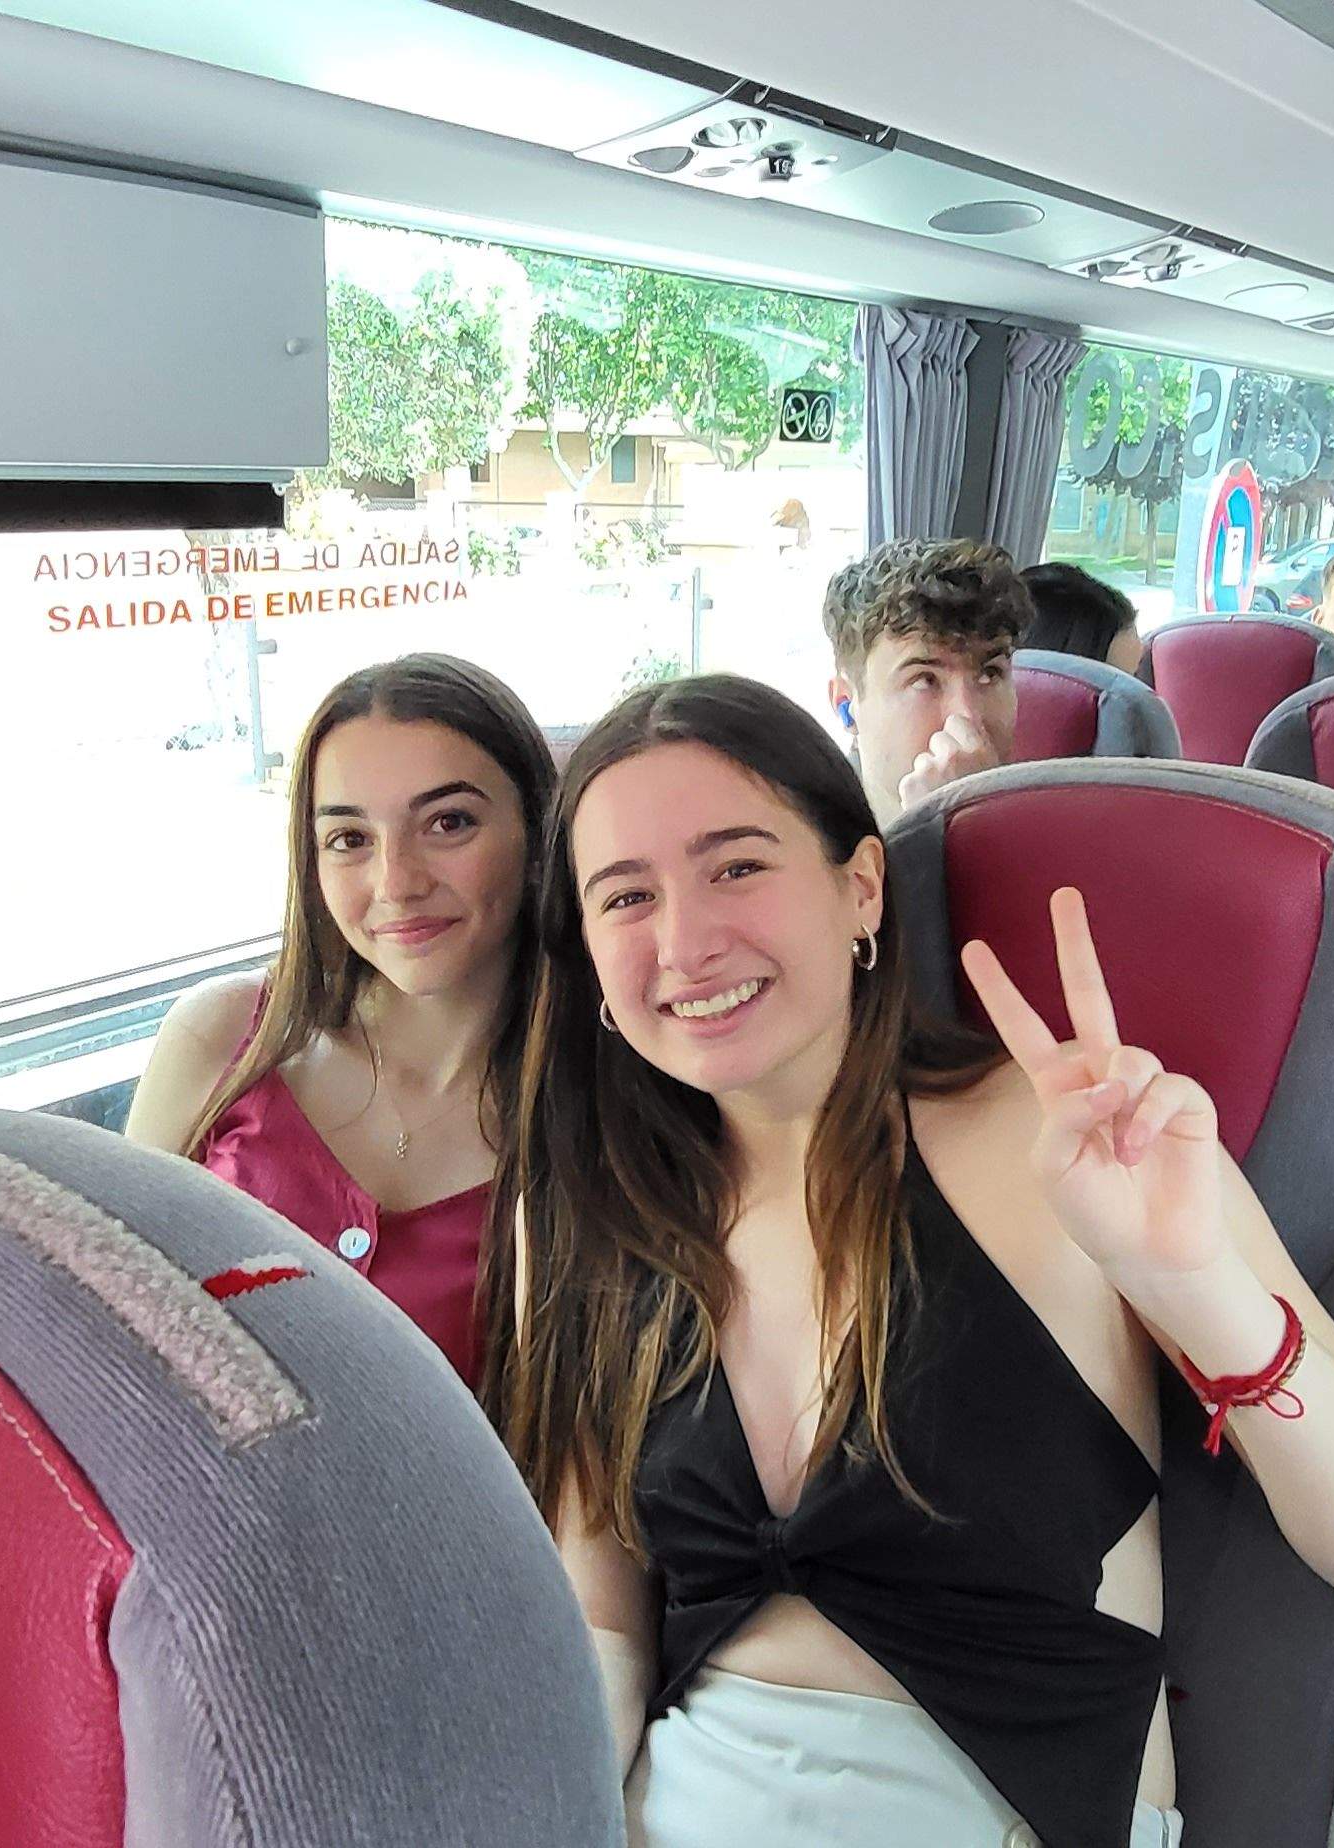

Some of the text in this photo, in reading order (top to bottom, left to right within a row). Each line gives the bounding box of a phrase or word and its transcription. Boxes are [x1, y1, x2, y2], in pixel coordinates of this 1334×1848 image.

[47, 580, 469, 633] SALIDA DE EMERGENCIA
